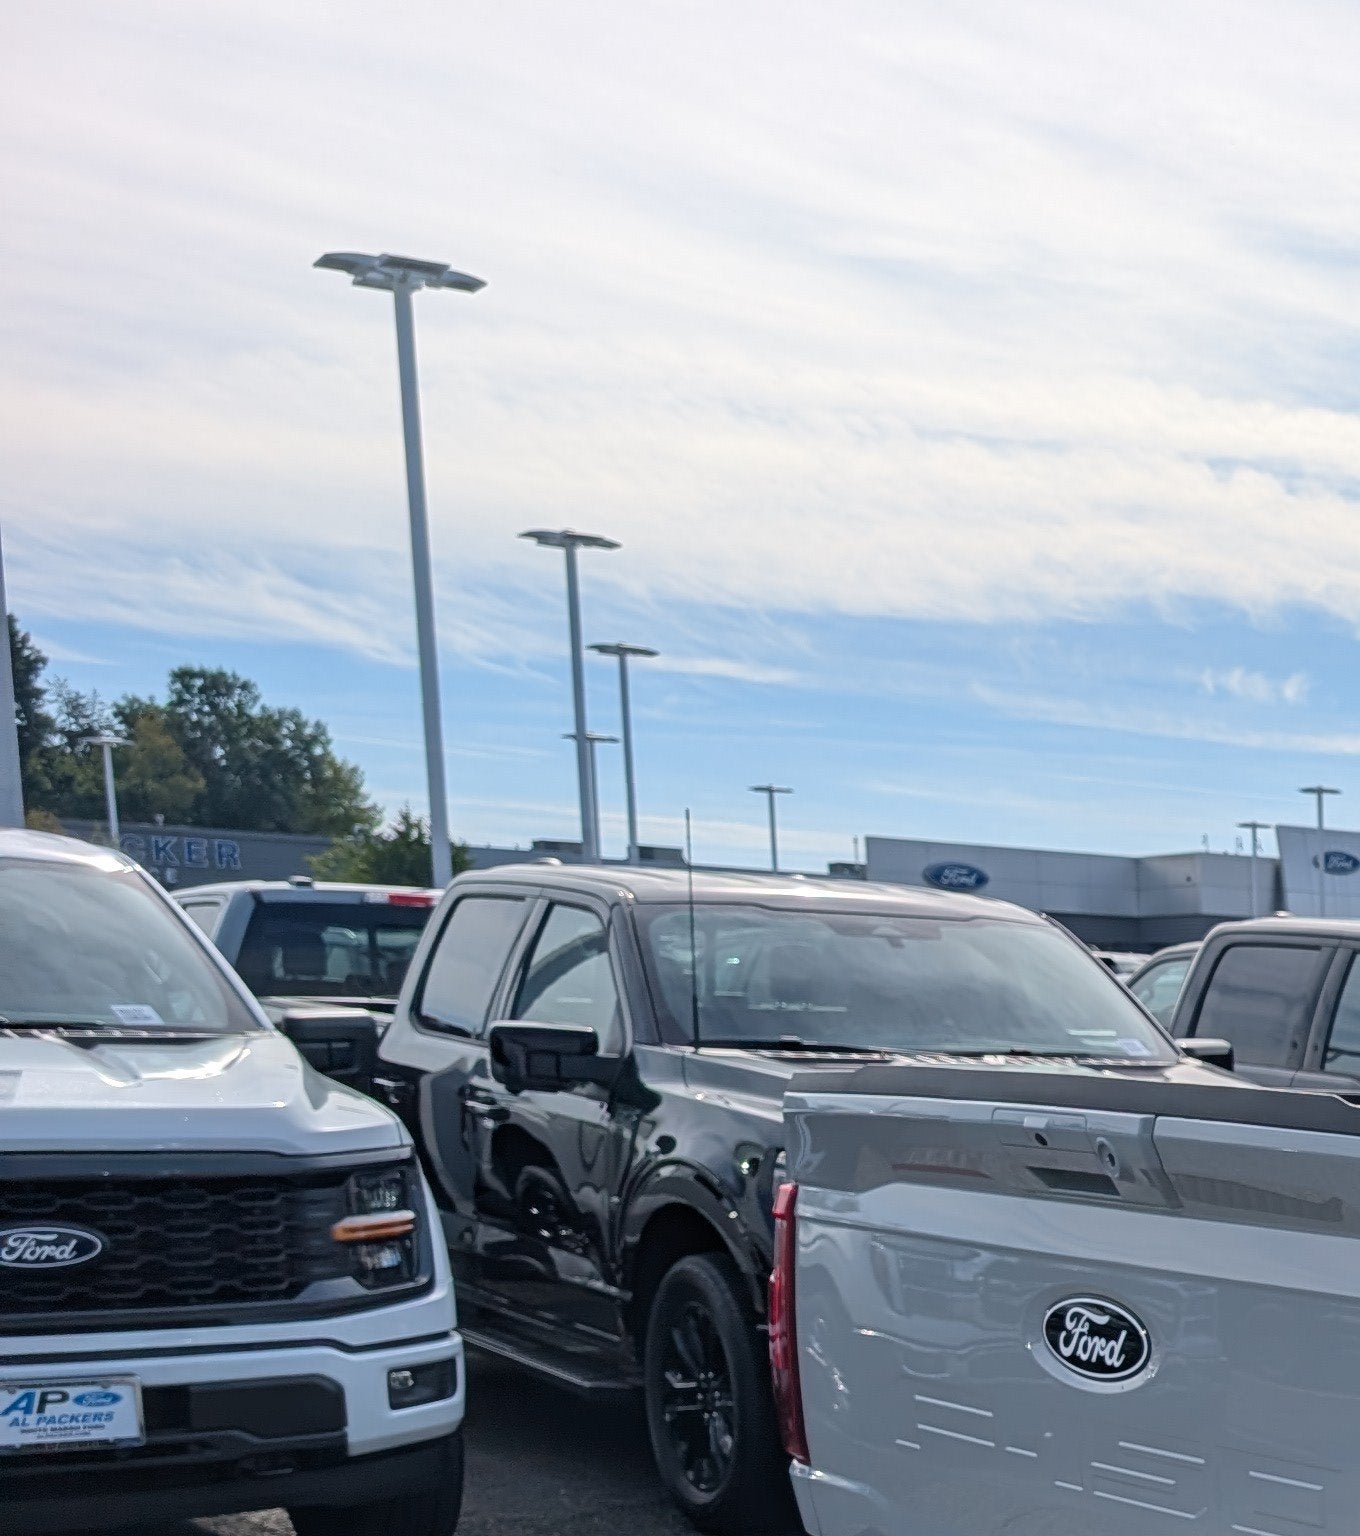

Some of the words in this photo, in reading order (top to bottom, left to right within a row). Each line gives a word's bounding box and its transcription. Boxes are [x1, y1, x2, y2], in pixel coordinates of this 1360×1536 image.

[0, 1232, 78, 1261] Ford
[1060, 1306, 1128, 1368] Ford
[0, 1390, 70, 1417] AP
[9, 1416, 30, 1428] AL
